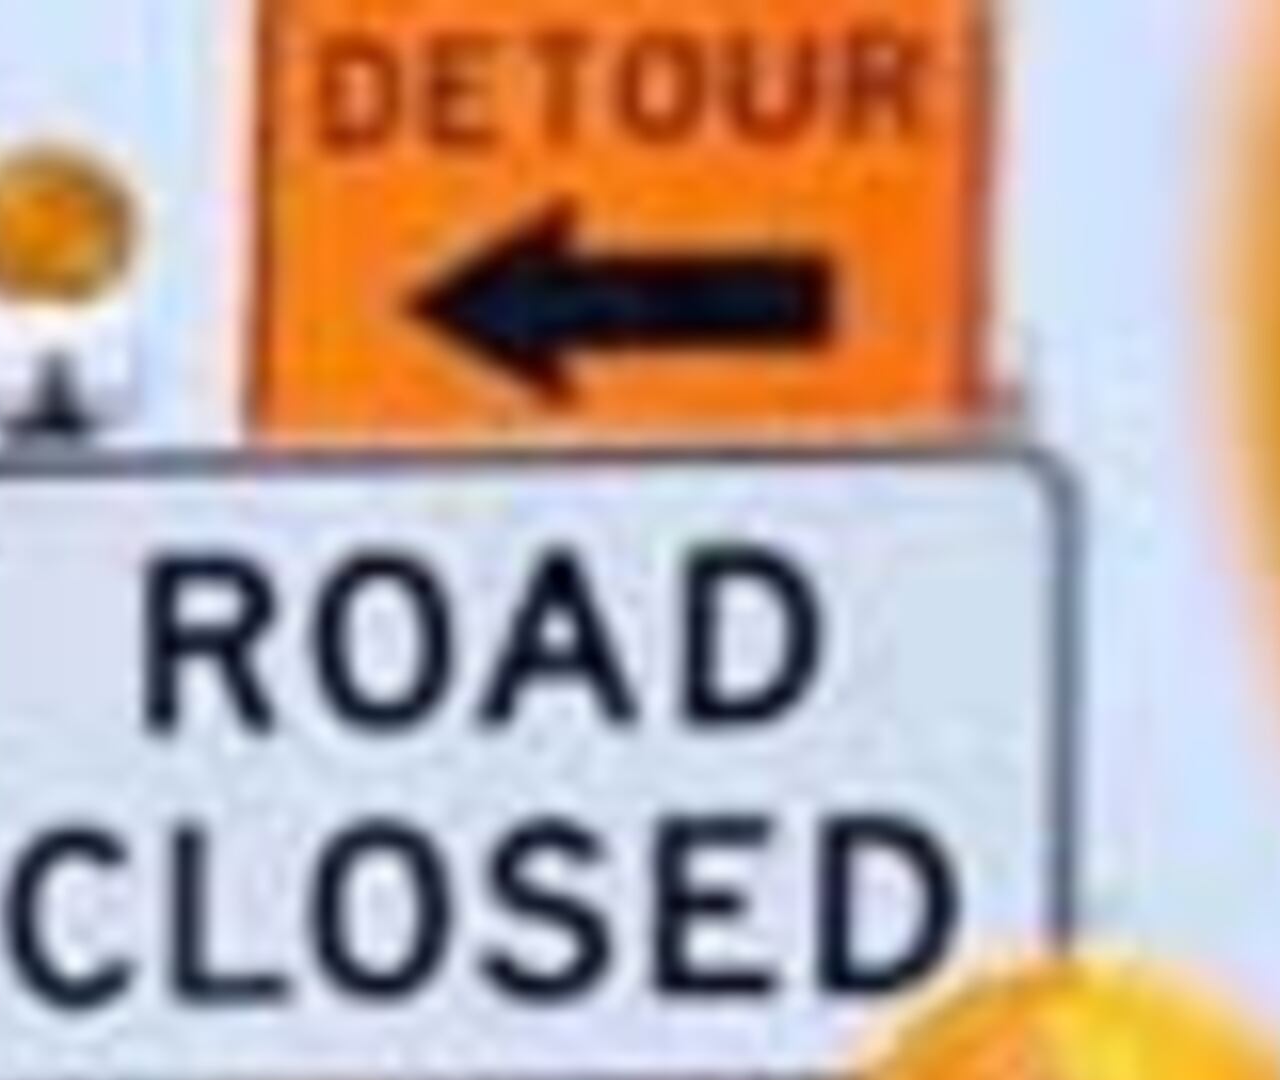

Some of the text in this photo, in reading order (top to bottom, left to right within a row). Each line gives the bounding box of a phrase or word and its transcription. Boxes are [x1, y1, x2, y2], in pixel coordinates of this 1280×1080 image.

[316, 28, 929, 154] DETOUR
[141, 541, 824, 736] ROAD
[1, 812, 963, 1013] CLOSED
